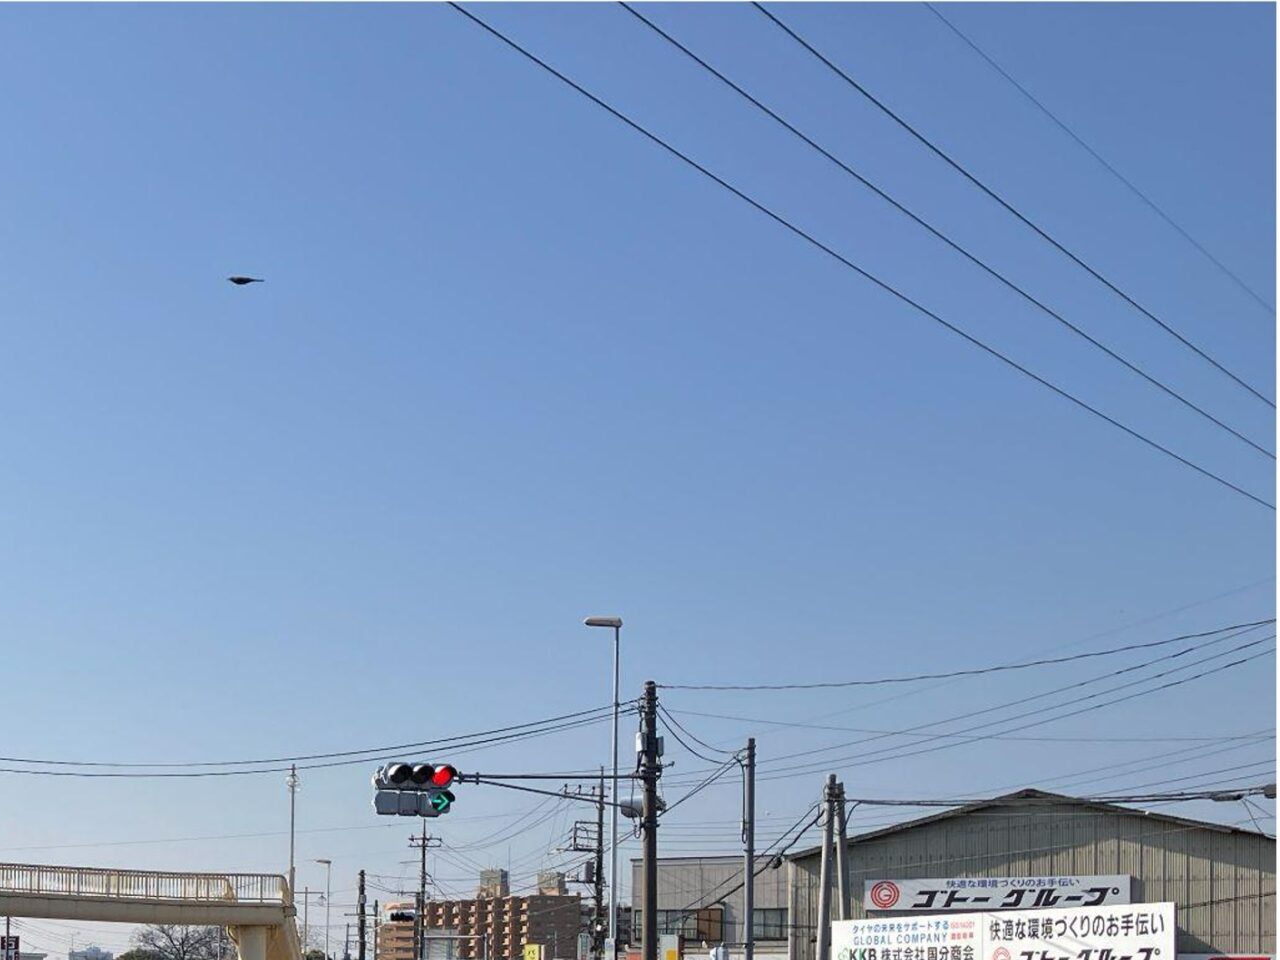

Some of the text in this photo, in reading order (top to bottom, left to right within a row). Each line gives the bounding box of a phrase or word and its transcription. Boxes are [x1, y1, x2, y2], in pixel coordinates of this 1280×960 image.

[946, 878, 1080, 889] 快適な環境づくりのお手伝い
[912, 887, 1120, 908] ゴトーグループ
[852, 921, 949, 934] タイヤの未来をサポートする
[989, 913, 1165, 941] 快適な環境づくりのお手伝い
[853, 934, 892, 946] GLOBAL
[896, 933, 947, 945] COMPANY
